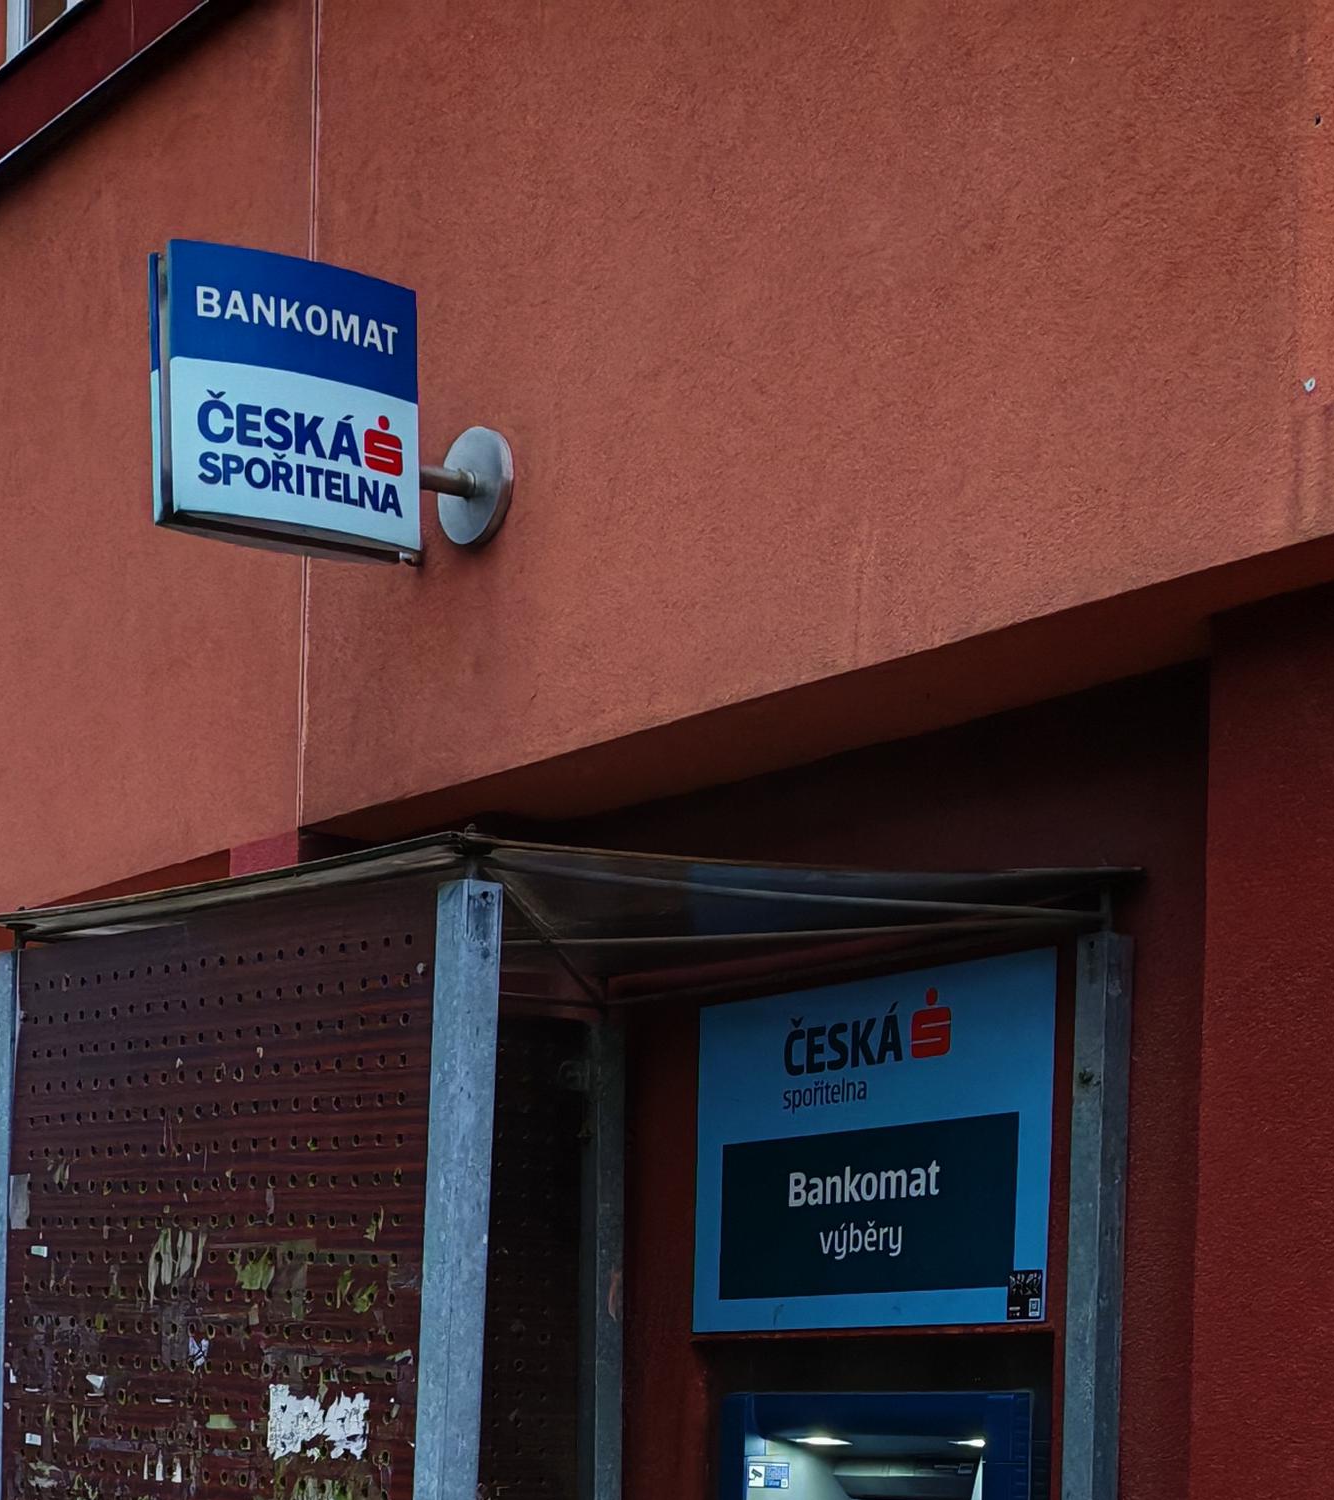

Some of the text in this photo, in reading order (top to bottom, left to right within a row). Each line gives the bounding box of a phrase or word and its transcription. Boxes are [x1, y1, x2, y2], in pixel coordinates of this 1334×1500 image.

[195, 285, 398, 355] BANKOMAT
[197, 389, 361, 467] ČESKÁ
[198, 451, 403, 518] SPOŘITELNA
[783, 1001, 903, 1077] ČESKÁ
[783, 1079, 867, 1114] spořitelna
[788, 1160, 940, 1207] Bankomat
[819, 1221, 903, 1260] výběry
